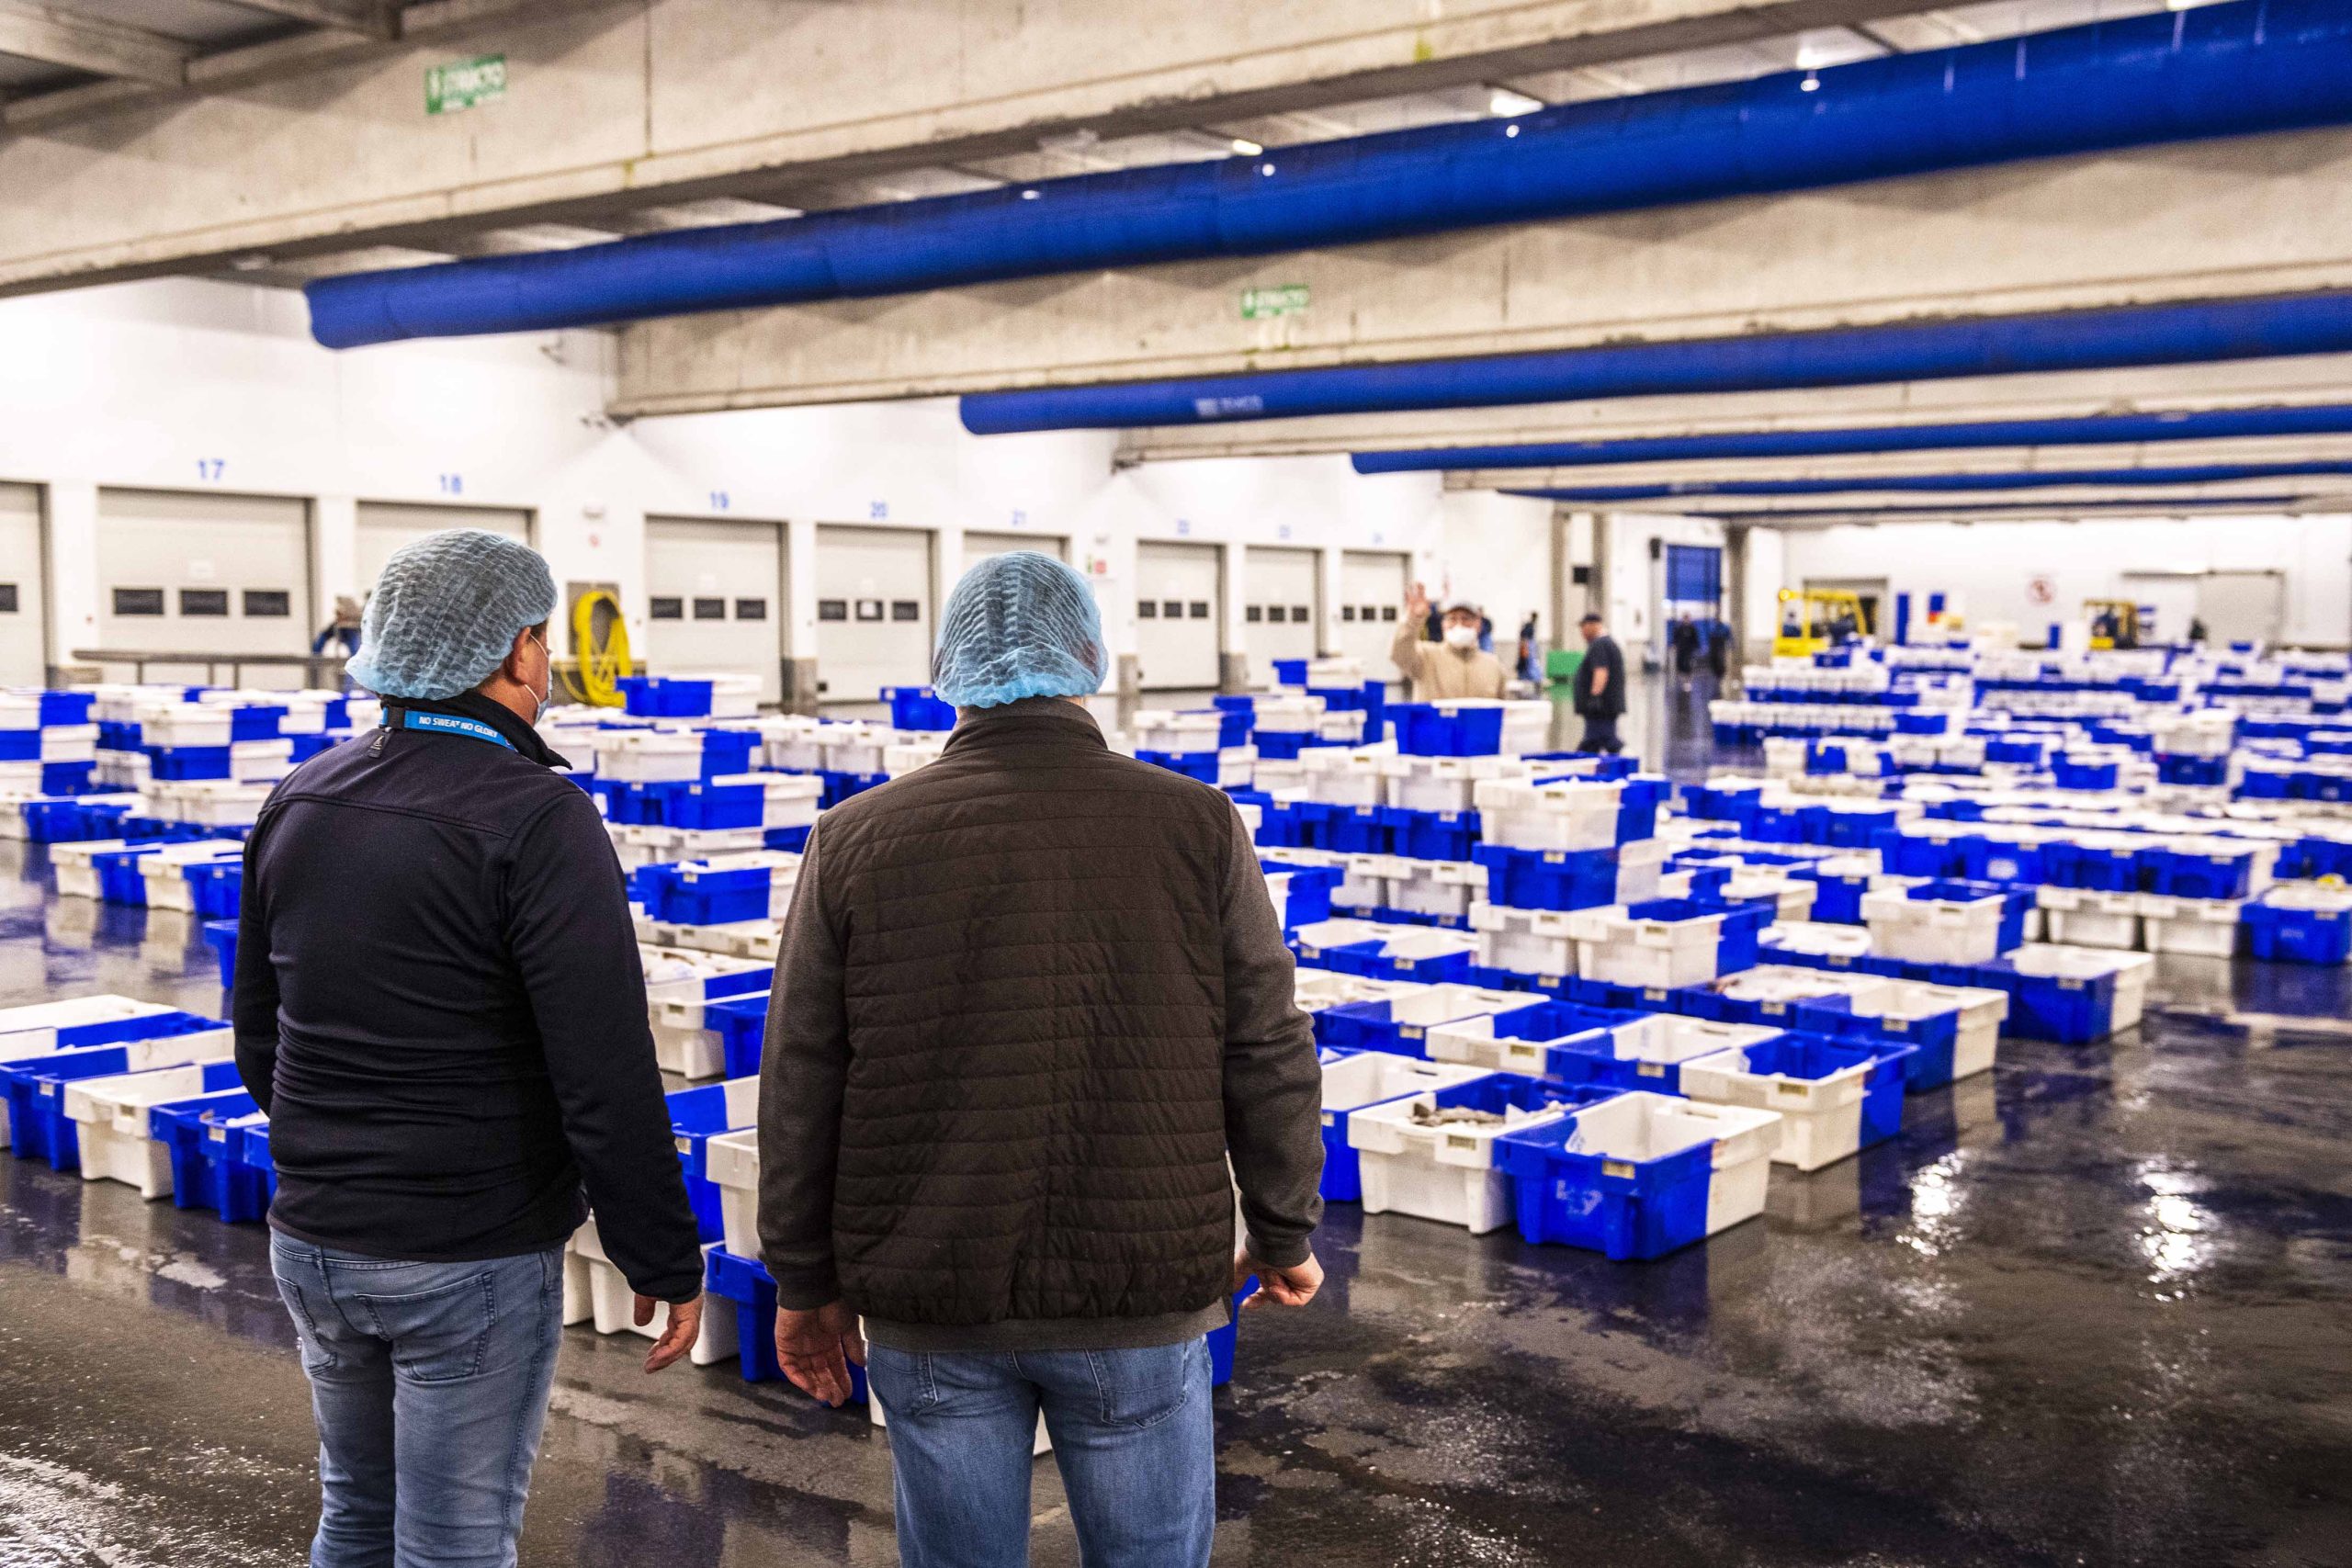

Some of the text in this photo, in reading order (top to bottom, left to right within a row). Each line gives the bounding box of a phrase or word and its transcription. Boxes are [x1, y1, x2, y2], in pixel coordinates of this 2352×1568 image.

[198, 458, 225, 479] 17
[440, 473, 463, 494] 18
[709, 491, 729, 510] 19
[419, 716, 498, 738] NO SWEAT NO GLORY
